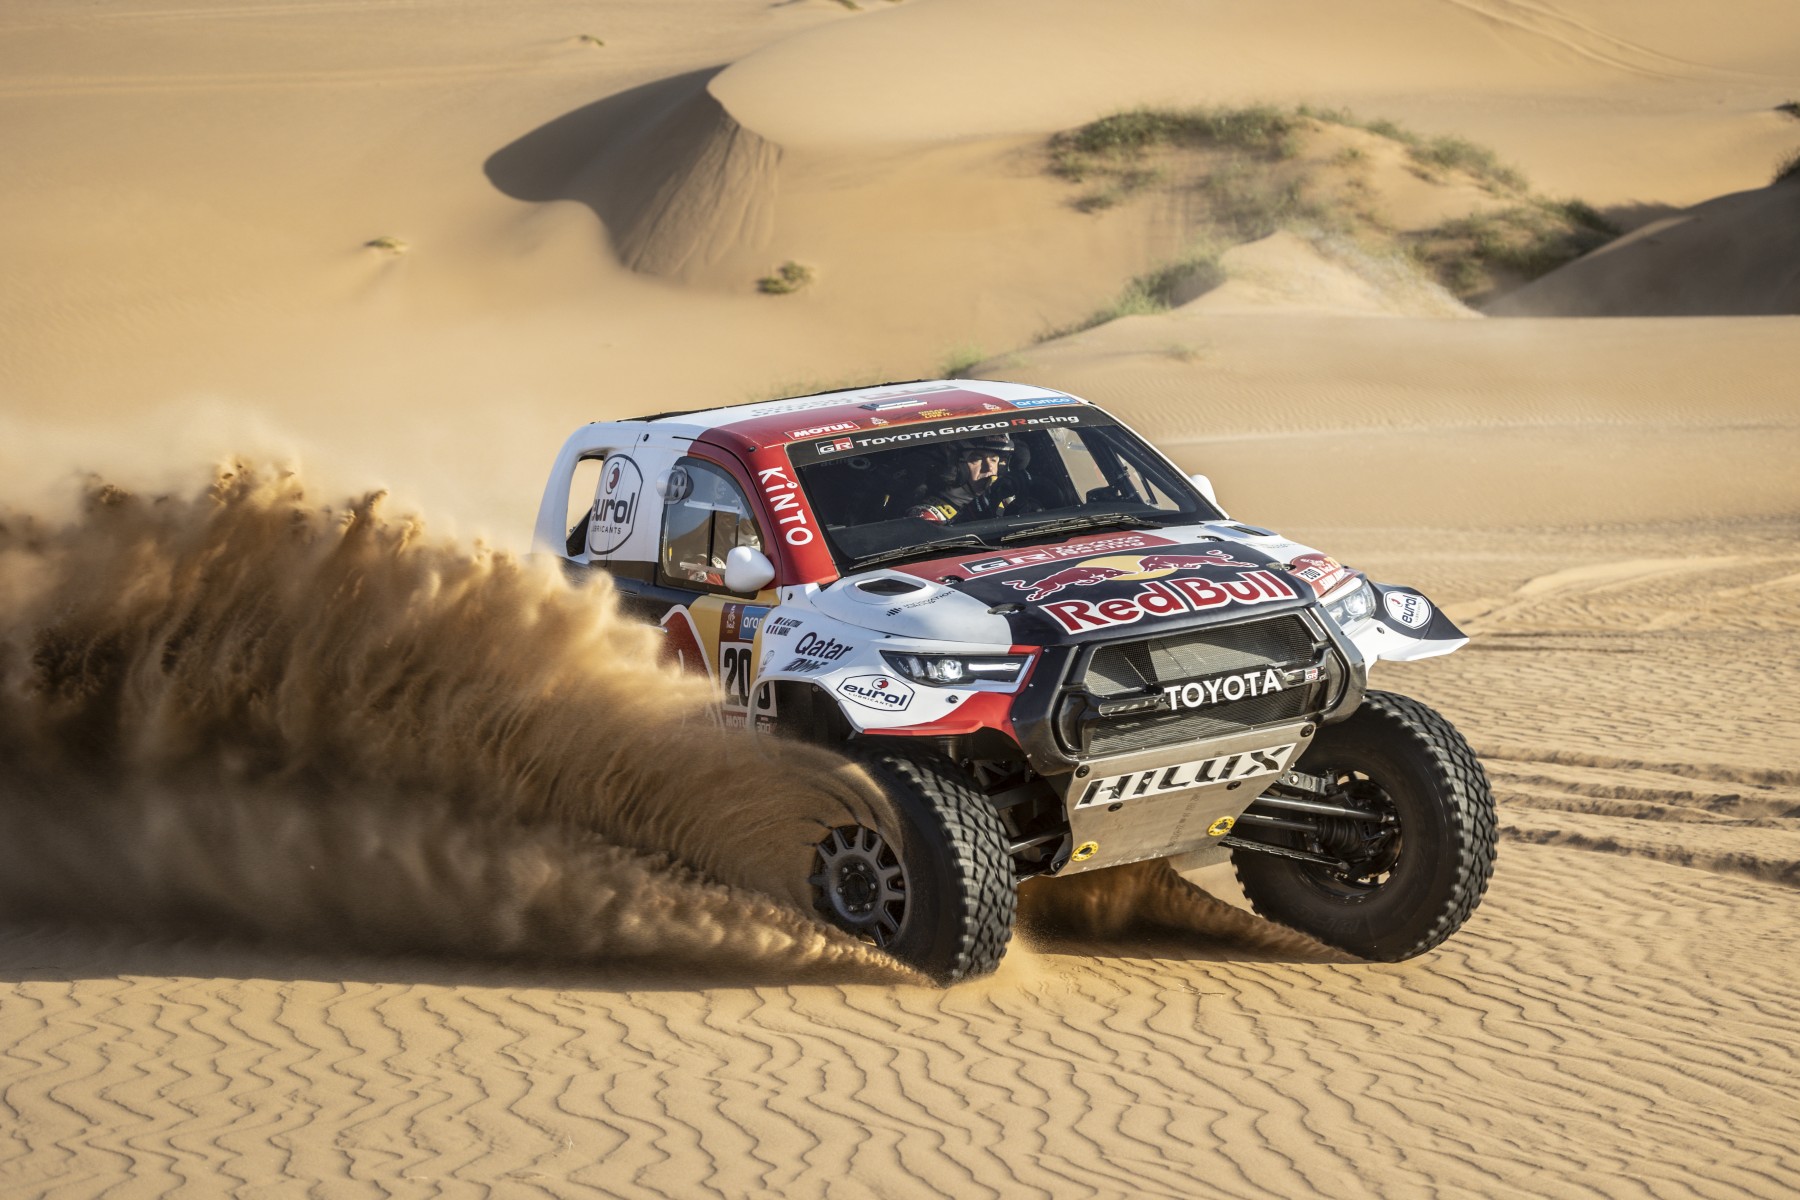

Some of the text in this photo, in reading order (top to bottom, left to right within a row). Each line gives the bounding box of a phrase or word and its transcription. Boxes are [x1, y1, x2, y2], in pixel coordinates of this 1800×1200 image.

[1016, 397, 1072, 407] aramco
[793, 423, 854, 438] MOTUL
[819, 415, 1080, 455] GR TOYOTA GAZOO Racing
[967, 553, 1048, 573] GR
[1041, 570, 1297, 634] Red Bull
[1401, 594, 1418, 624] eurol
[795, 632, 853, 660] Qatar
[843, 684, 908, 707] eurol
[1164, 668, 1284, 711] TOYOTA
[1079, 745, 1291, 806] HILUX
